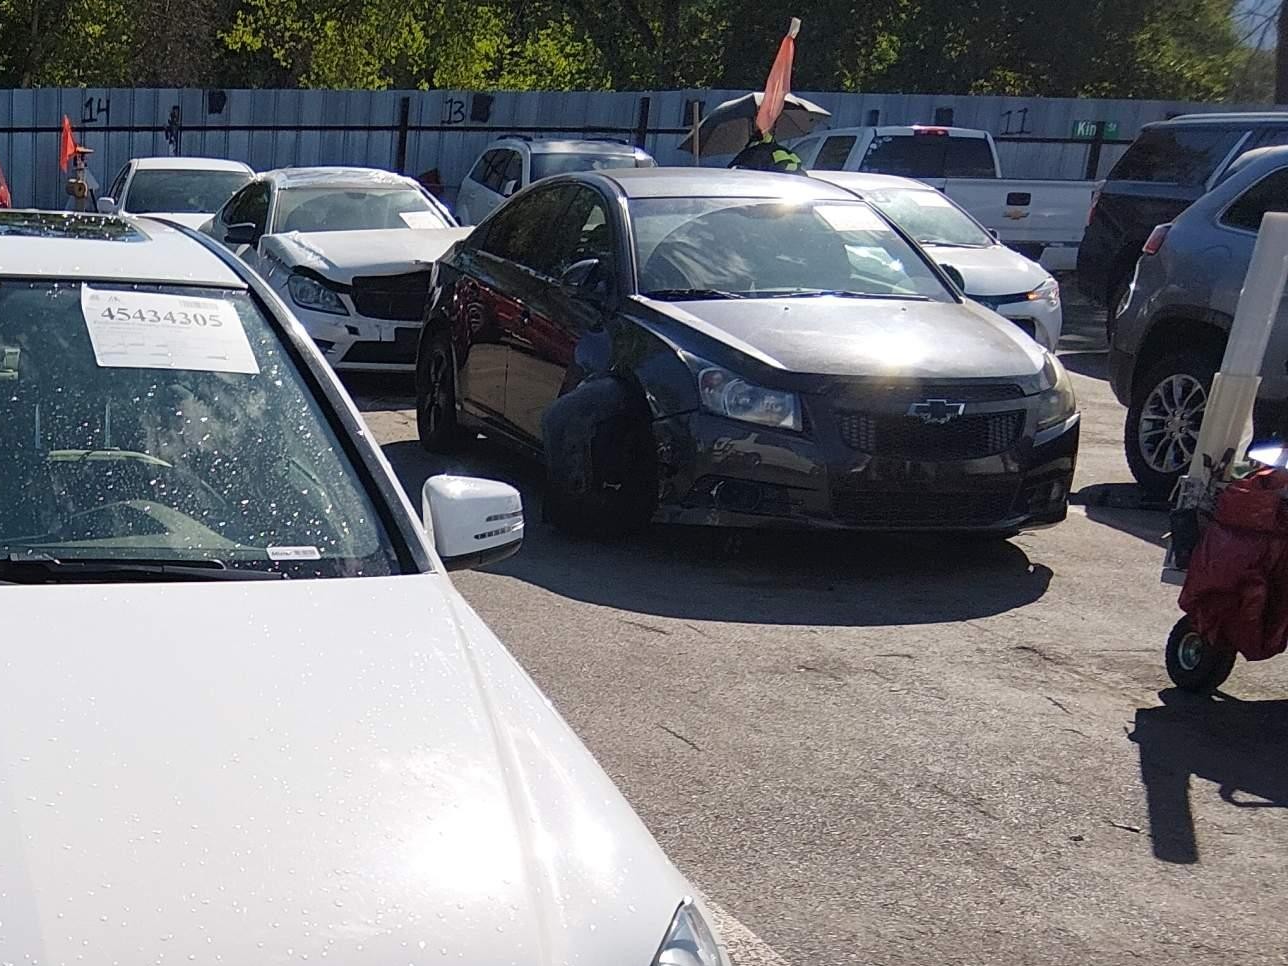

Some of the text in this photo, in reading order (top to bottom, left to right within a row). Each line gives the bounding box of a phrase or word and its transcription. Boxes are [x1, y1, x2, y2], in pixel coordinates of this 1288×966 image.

[82, 97, 110, 125] 14
[442, 98, 465, 124] 13
[1001, 107, 1031, 135] 11
[101, 306, 224, 328] 45434305
